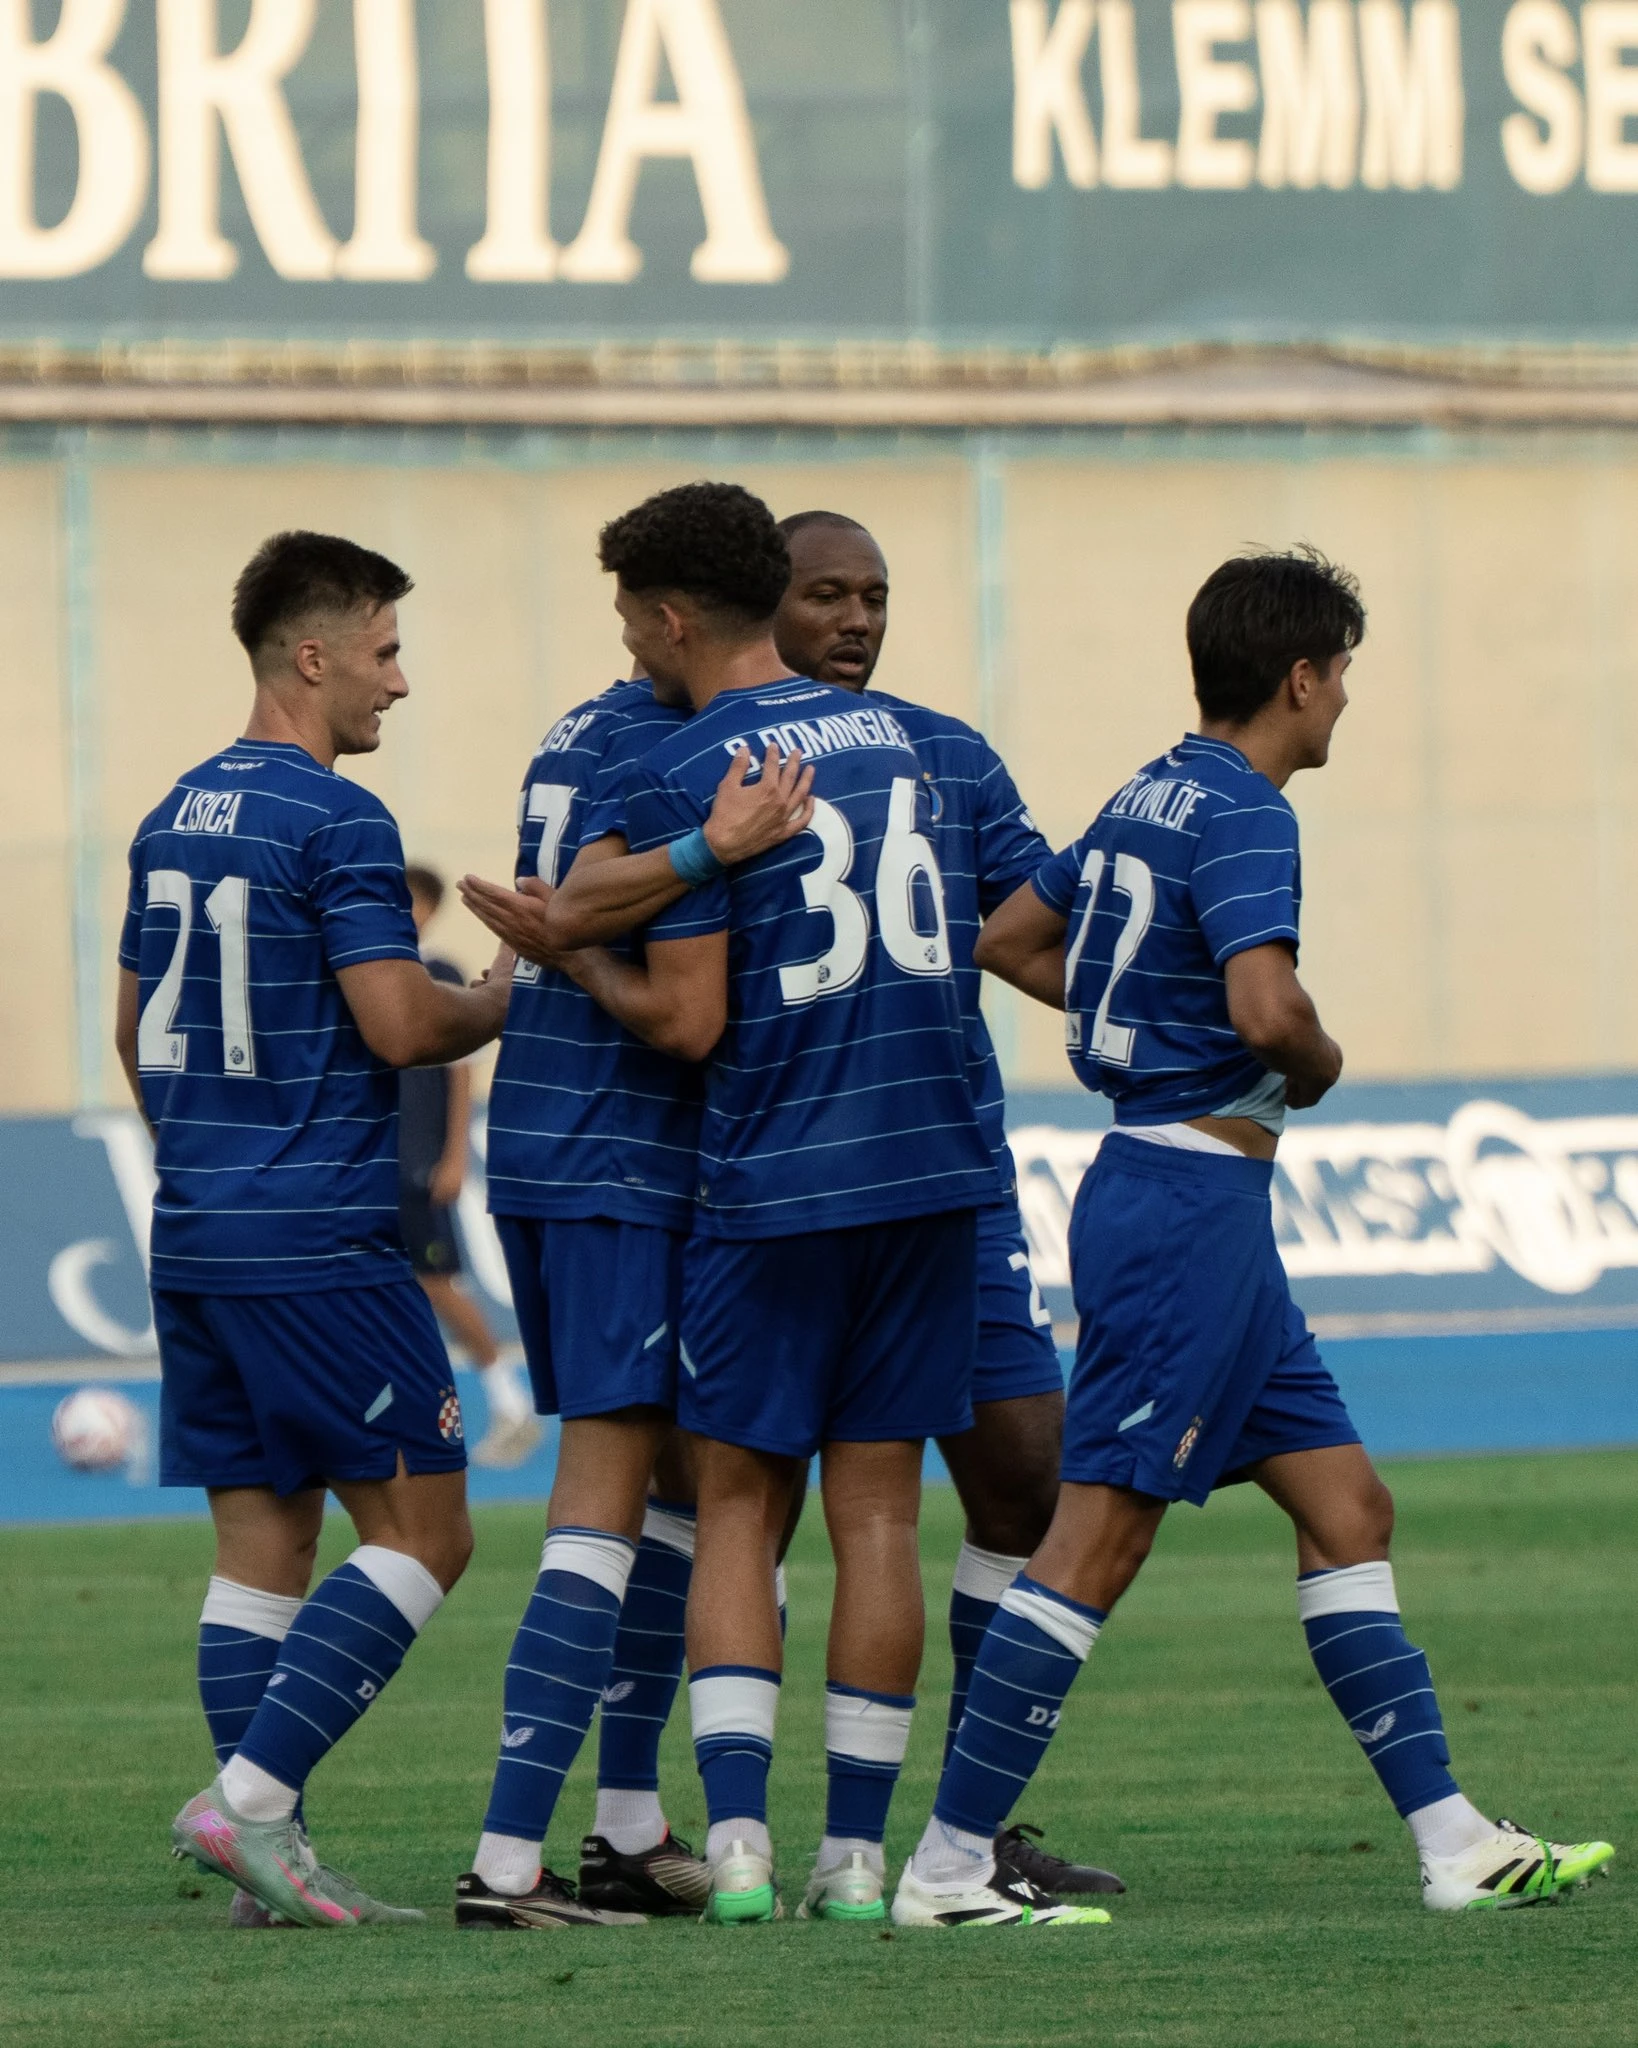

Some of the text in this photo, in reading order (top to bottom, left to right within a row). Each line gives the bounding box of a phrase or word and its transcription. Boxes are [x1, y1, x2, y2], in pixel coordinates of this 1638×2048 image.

[1008, 0, 1464, 191] KLEMM
[757, 709, 915, 766] DOMINGUE
[137, 869, 256, 1077] 21
[779, 777, 951, 1005] 36
[1064, 849, 1156, 1067] 22
